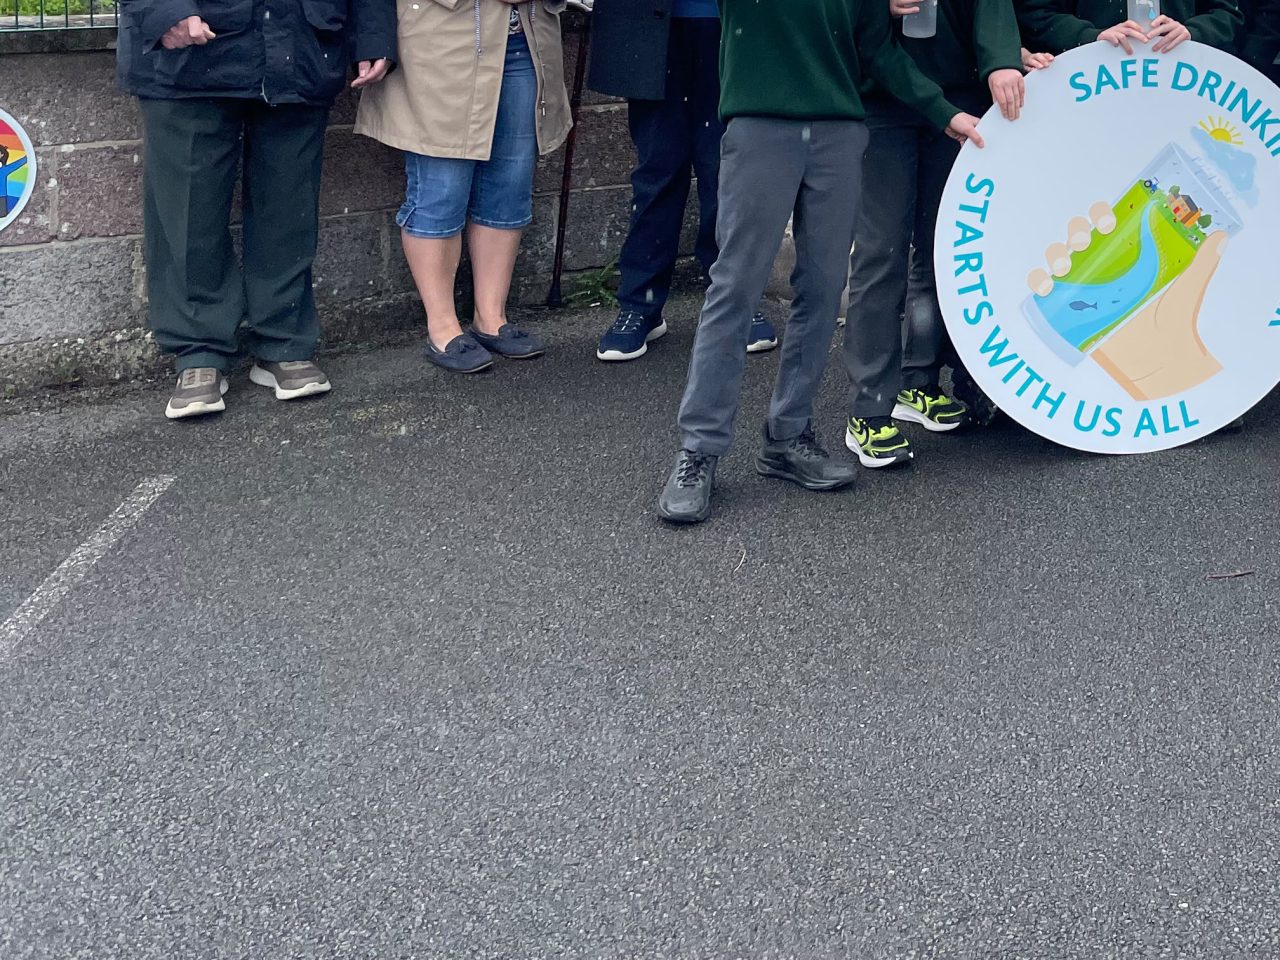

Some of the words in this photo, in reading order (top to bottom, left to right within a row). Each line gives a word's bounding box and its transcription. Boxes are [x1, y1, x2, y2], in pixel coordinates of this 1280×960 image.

[1069, 59, 1158, 102] SAFE
[953, 172, 995, 326] STARTS
[979, 325, 1067, 419] WITH
[1074, 400, 1123, 437] US
[1133, 400, 1200, 438] ALL
